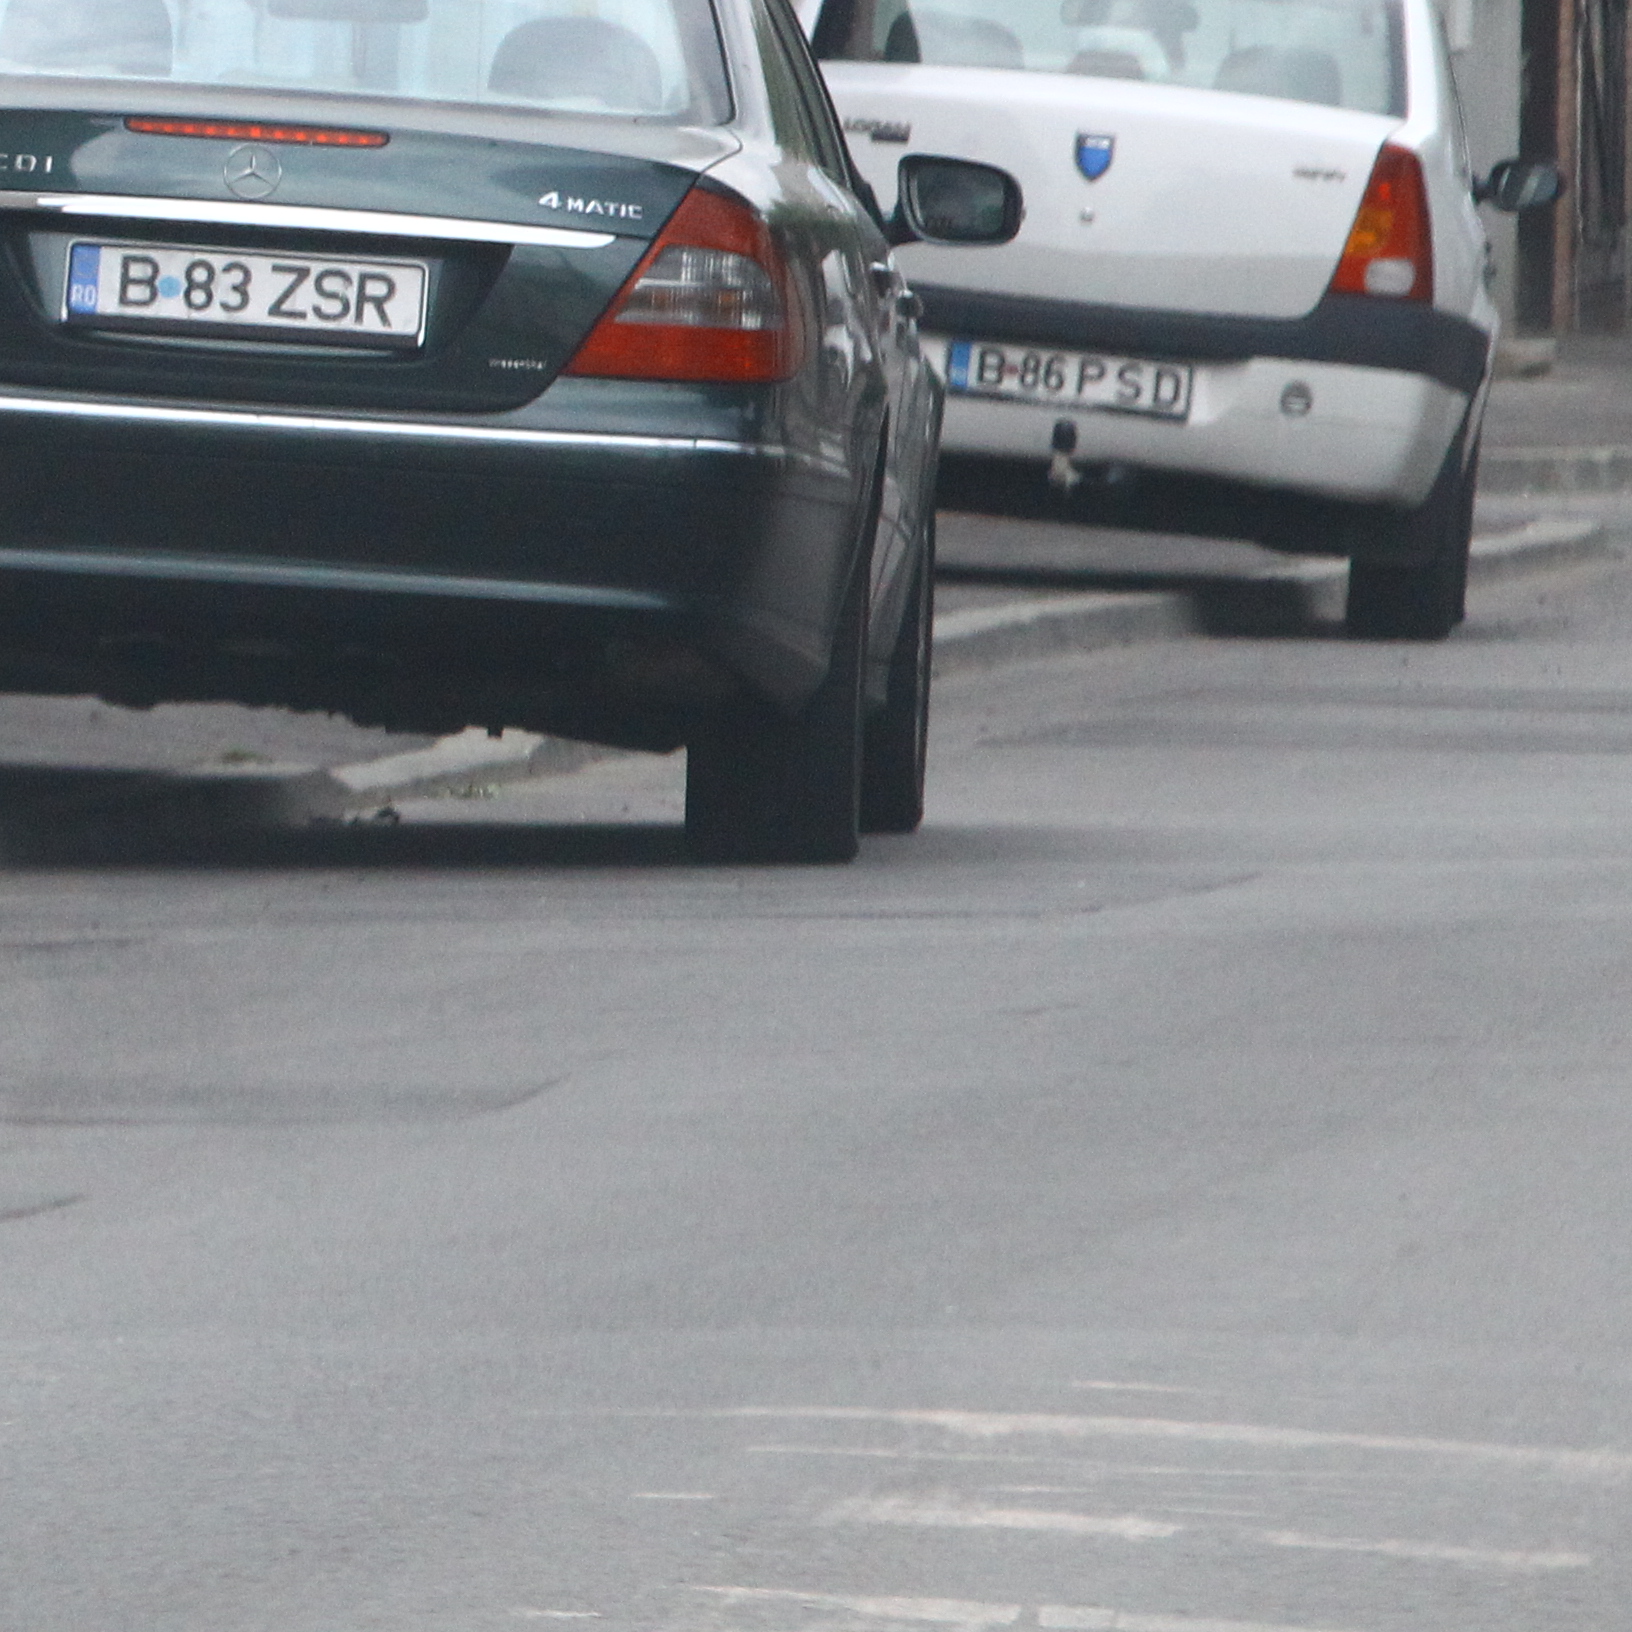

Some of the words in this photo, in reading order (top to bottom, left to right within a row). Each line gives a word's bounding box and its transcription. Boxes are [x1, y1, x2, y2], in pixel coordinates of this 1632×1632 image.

[71, 285, 96, 307] RO
[118, 254, 160, 307] B
[184, 259, 252, 313] 83
[267, 264, 397, 328] ZSR
